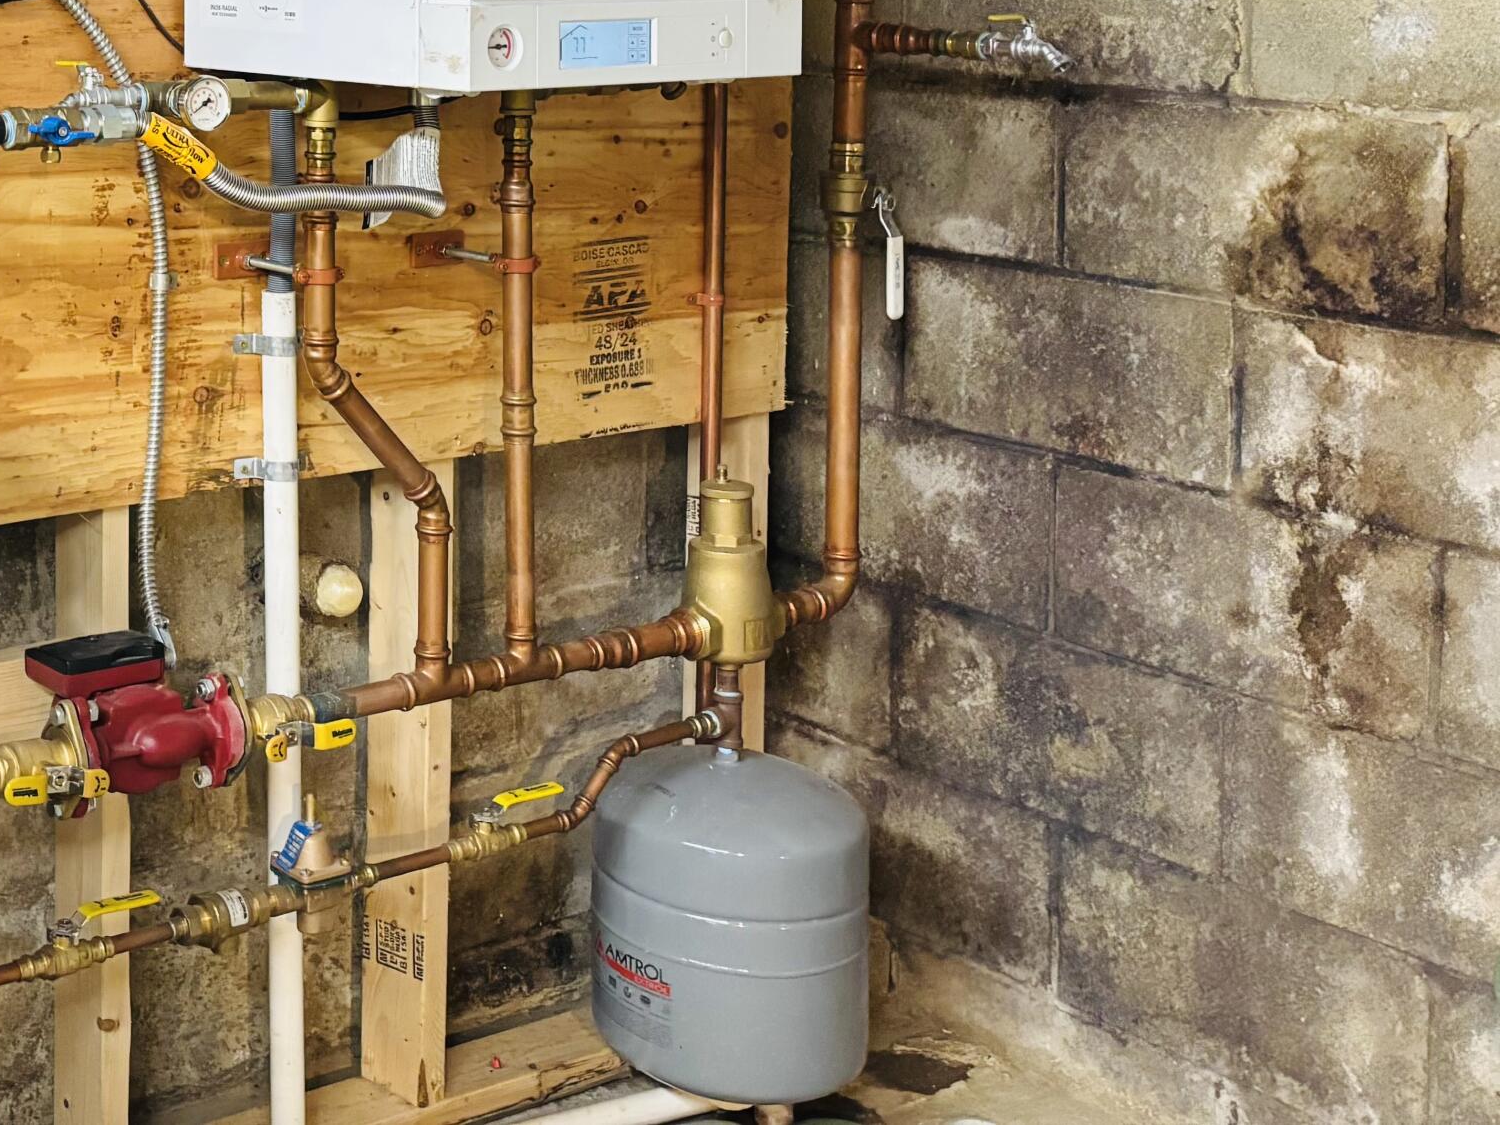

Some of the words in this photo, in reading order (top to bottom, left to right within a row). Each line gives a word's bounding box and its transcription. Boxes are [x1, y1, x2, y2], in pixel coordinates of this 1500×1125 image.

[166, 126, 189, 148] ULTRA
[573, 247, 604, 262] BOISE
[595, 332, 638, 352] 48/24
[589, 349, 635, 366] EXPOSURE
[605, 943, 668, 986] AMTROL
